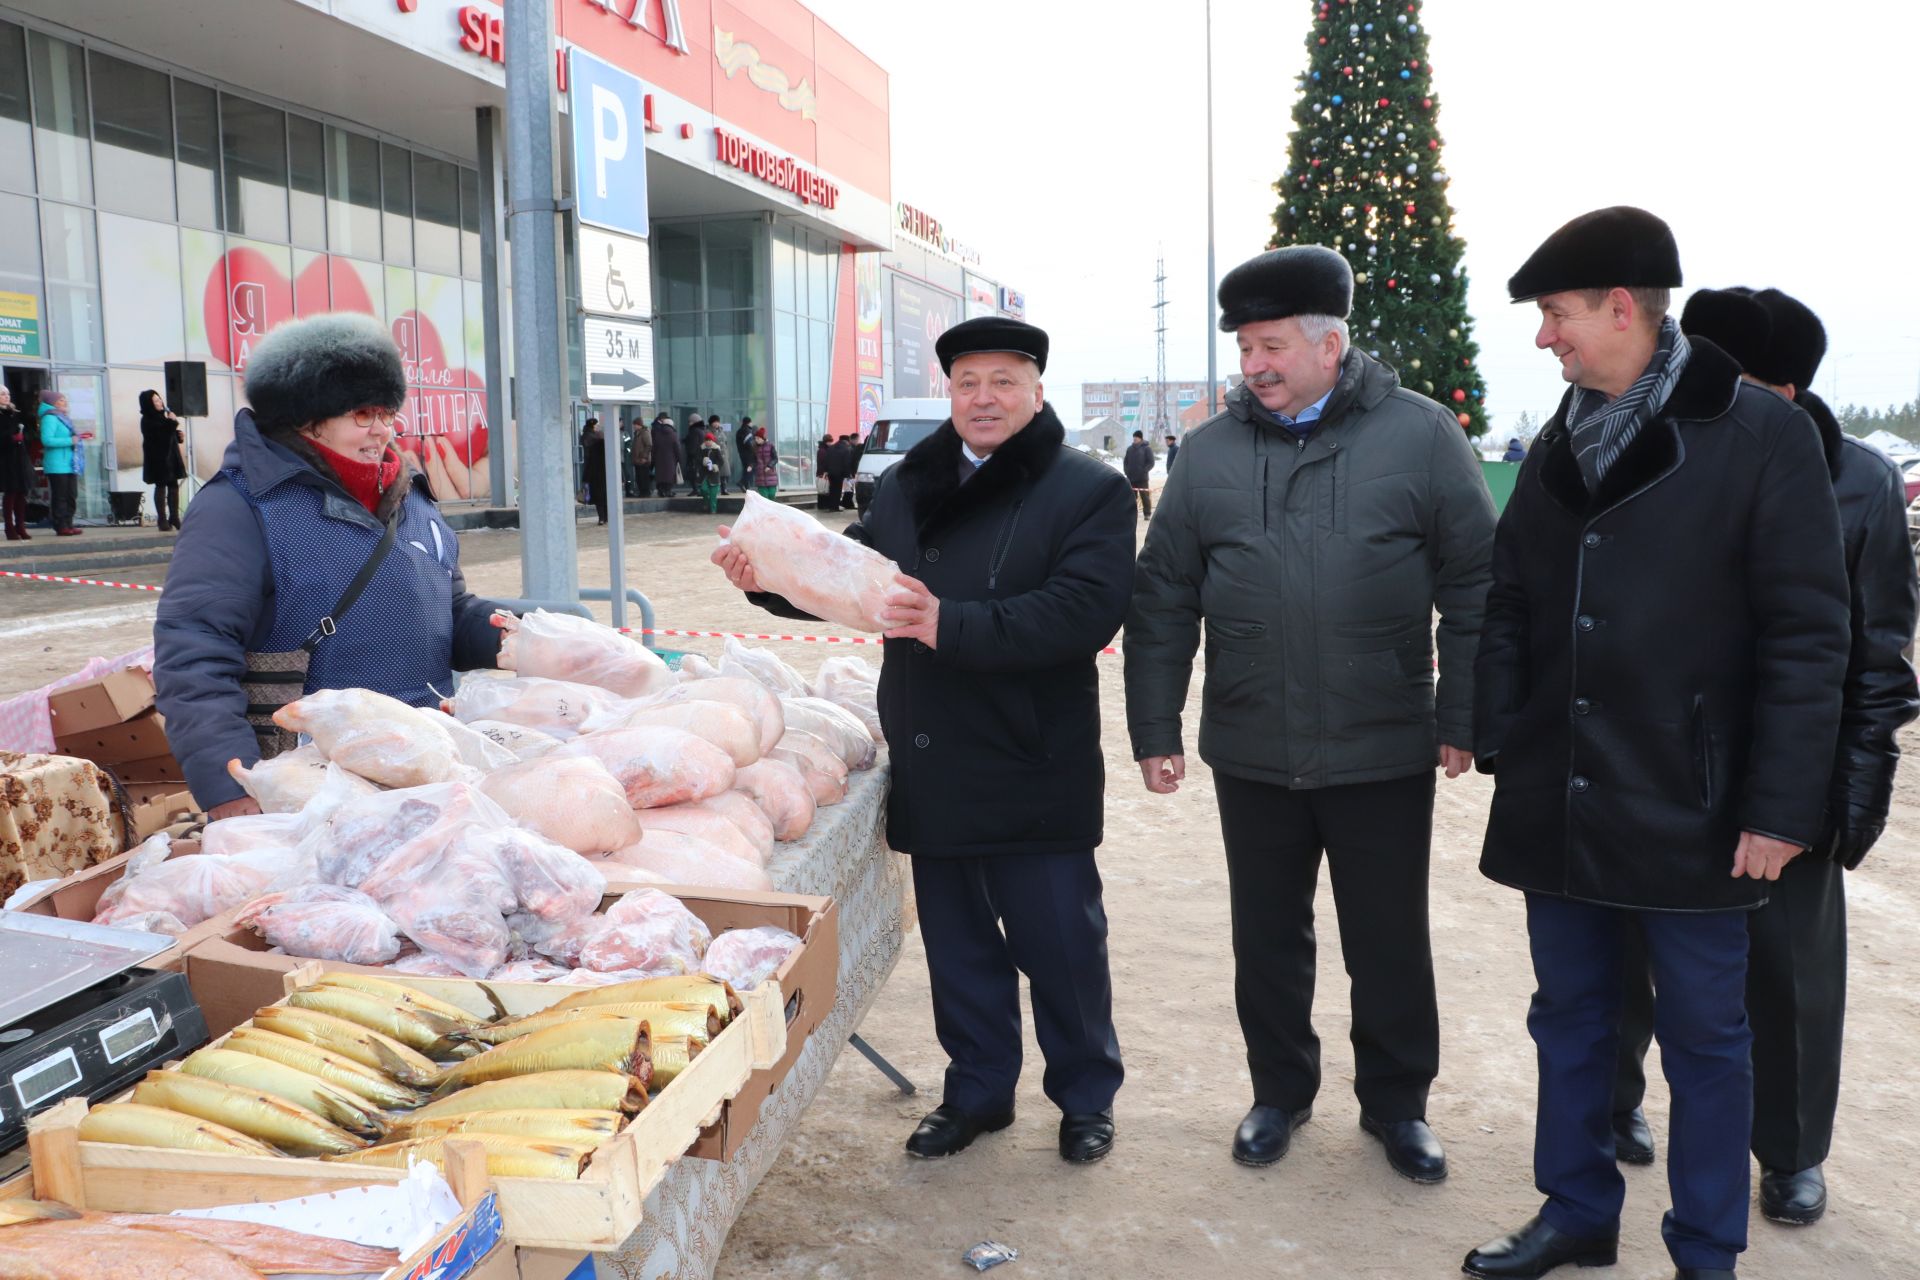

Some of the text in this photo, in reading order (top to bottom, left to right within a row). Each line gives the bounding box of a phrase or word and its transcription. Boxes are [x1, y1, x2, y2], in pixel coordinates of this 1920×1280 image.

[592, 83, 628, 199] P
[714, 127, 840, 209] ТОРГОВЫЙ ЦЕНТР
[232, 281, 267, 336] Я
[605, 329, 623, 359] 35
